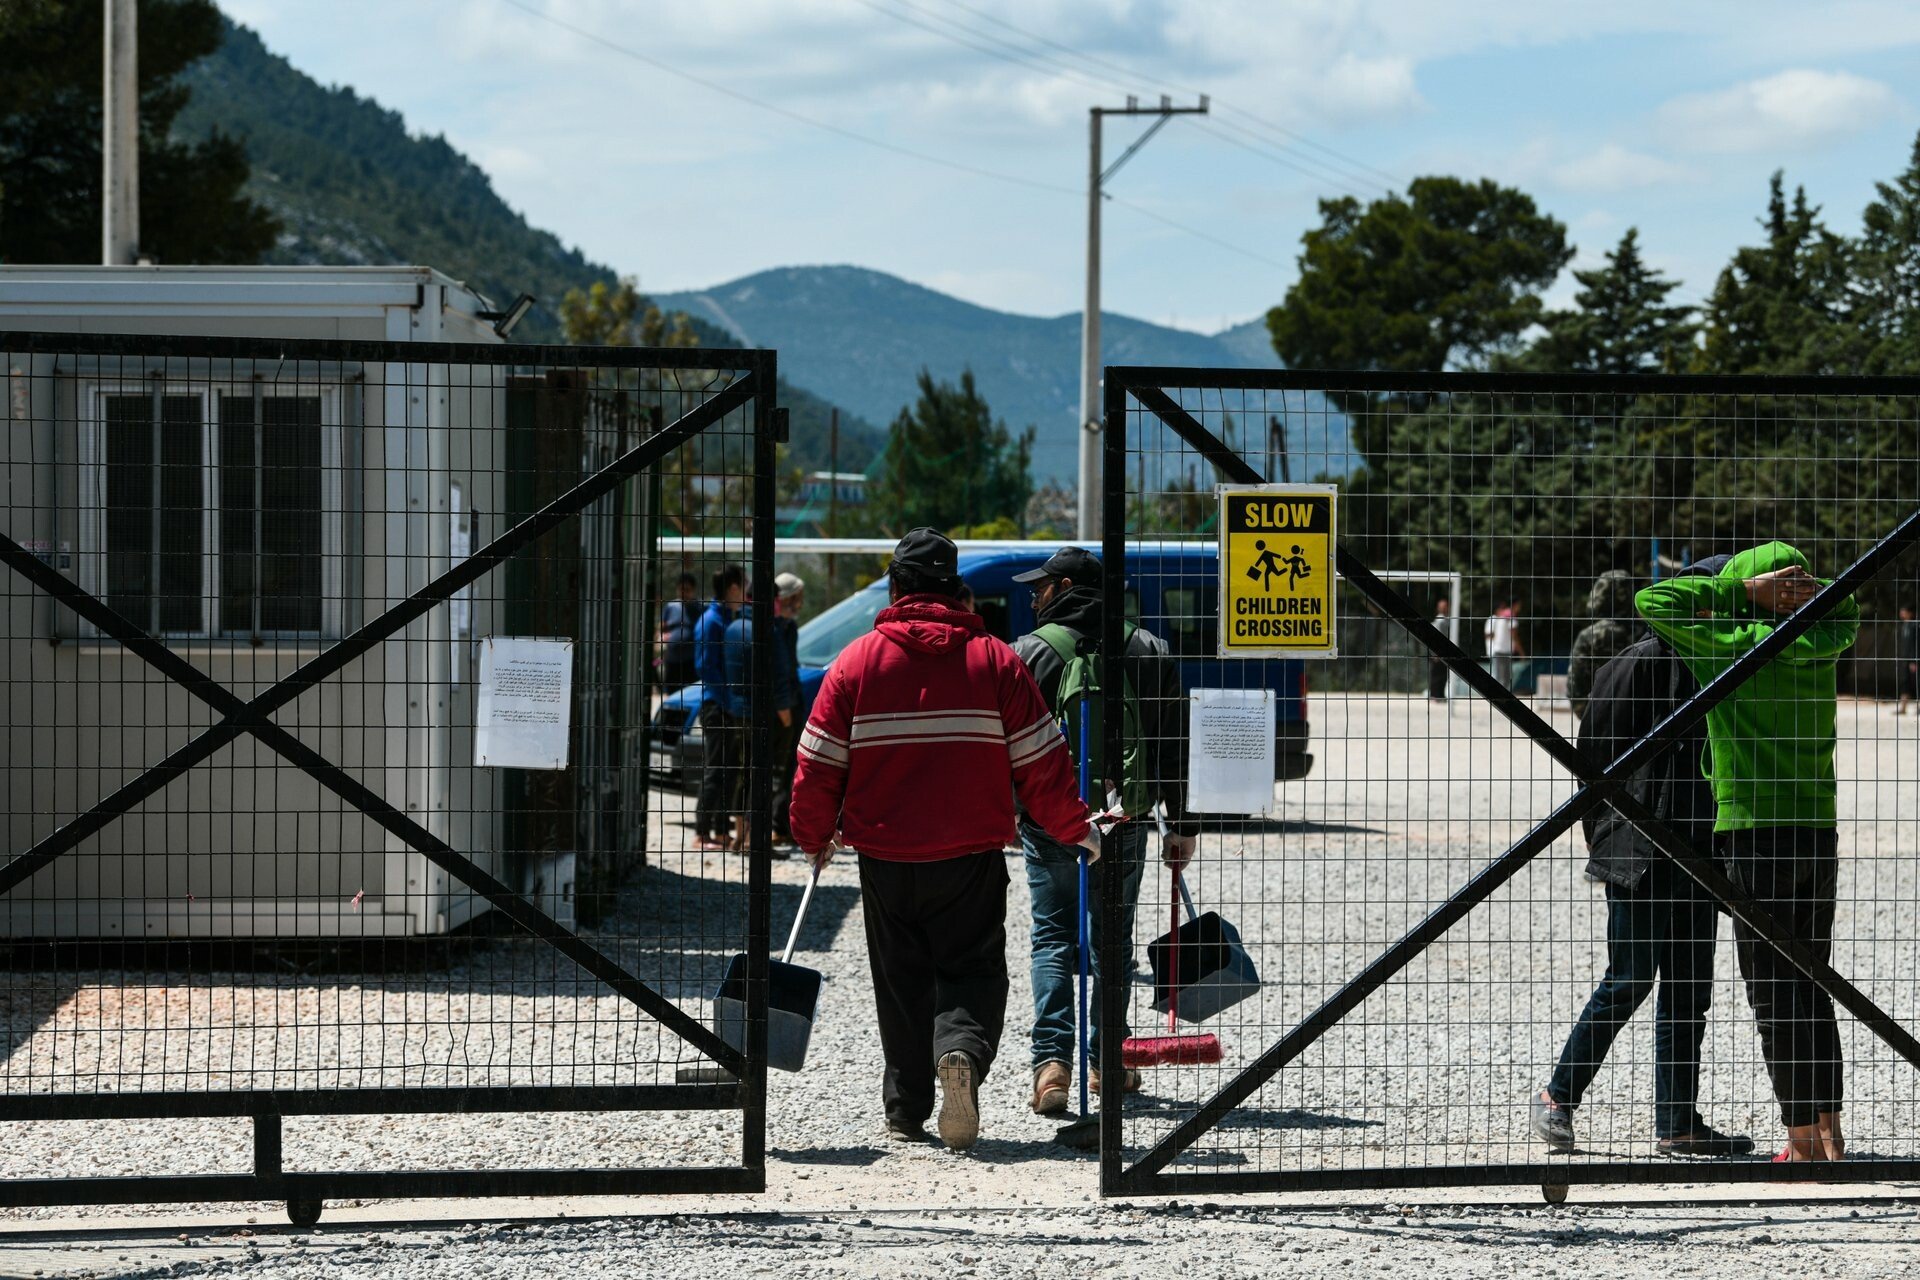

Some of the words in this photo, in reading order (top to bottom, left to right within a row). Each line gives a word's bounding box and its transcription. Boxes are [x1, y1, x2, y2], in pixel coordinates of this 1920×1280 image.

[1245, 503, 1313, 528] SLOW
[1236, 597, 1321, 615] CHILDREN
[1236, 619, 1322, 637] CROSSING
